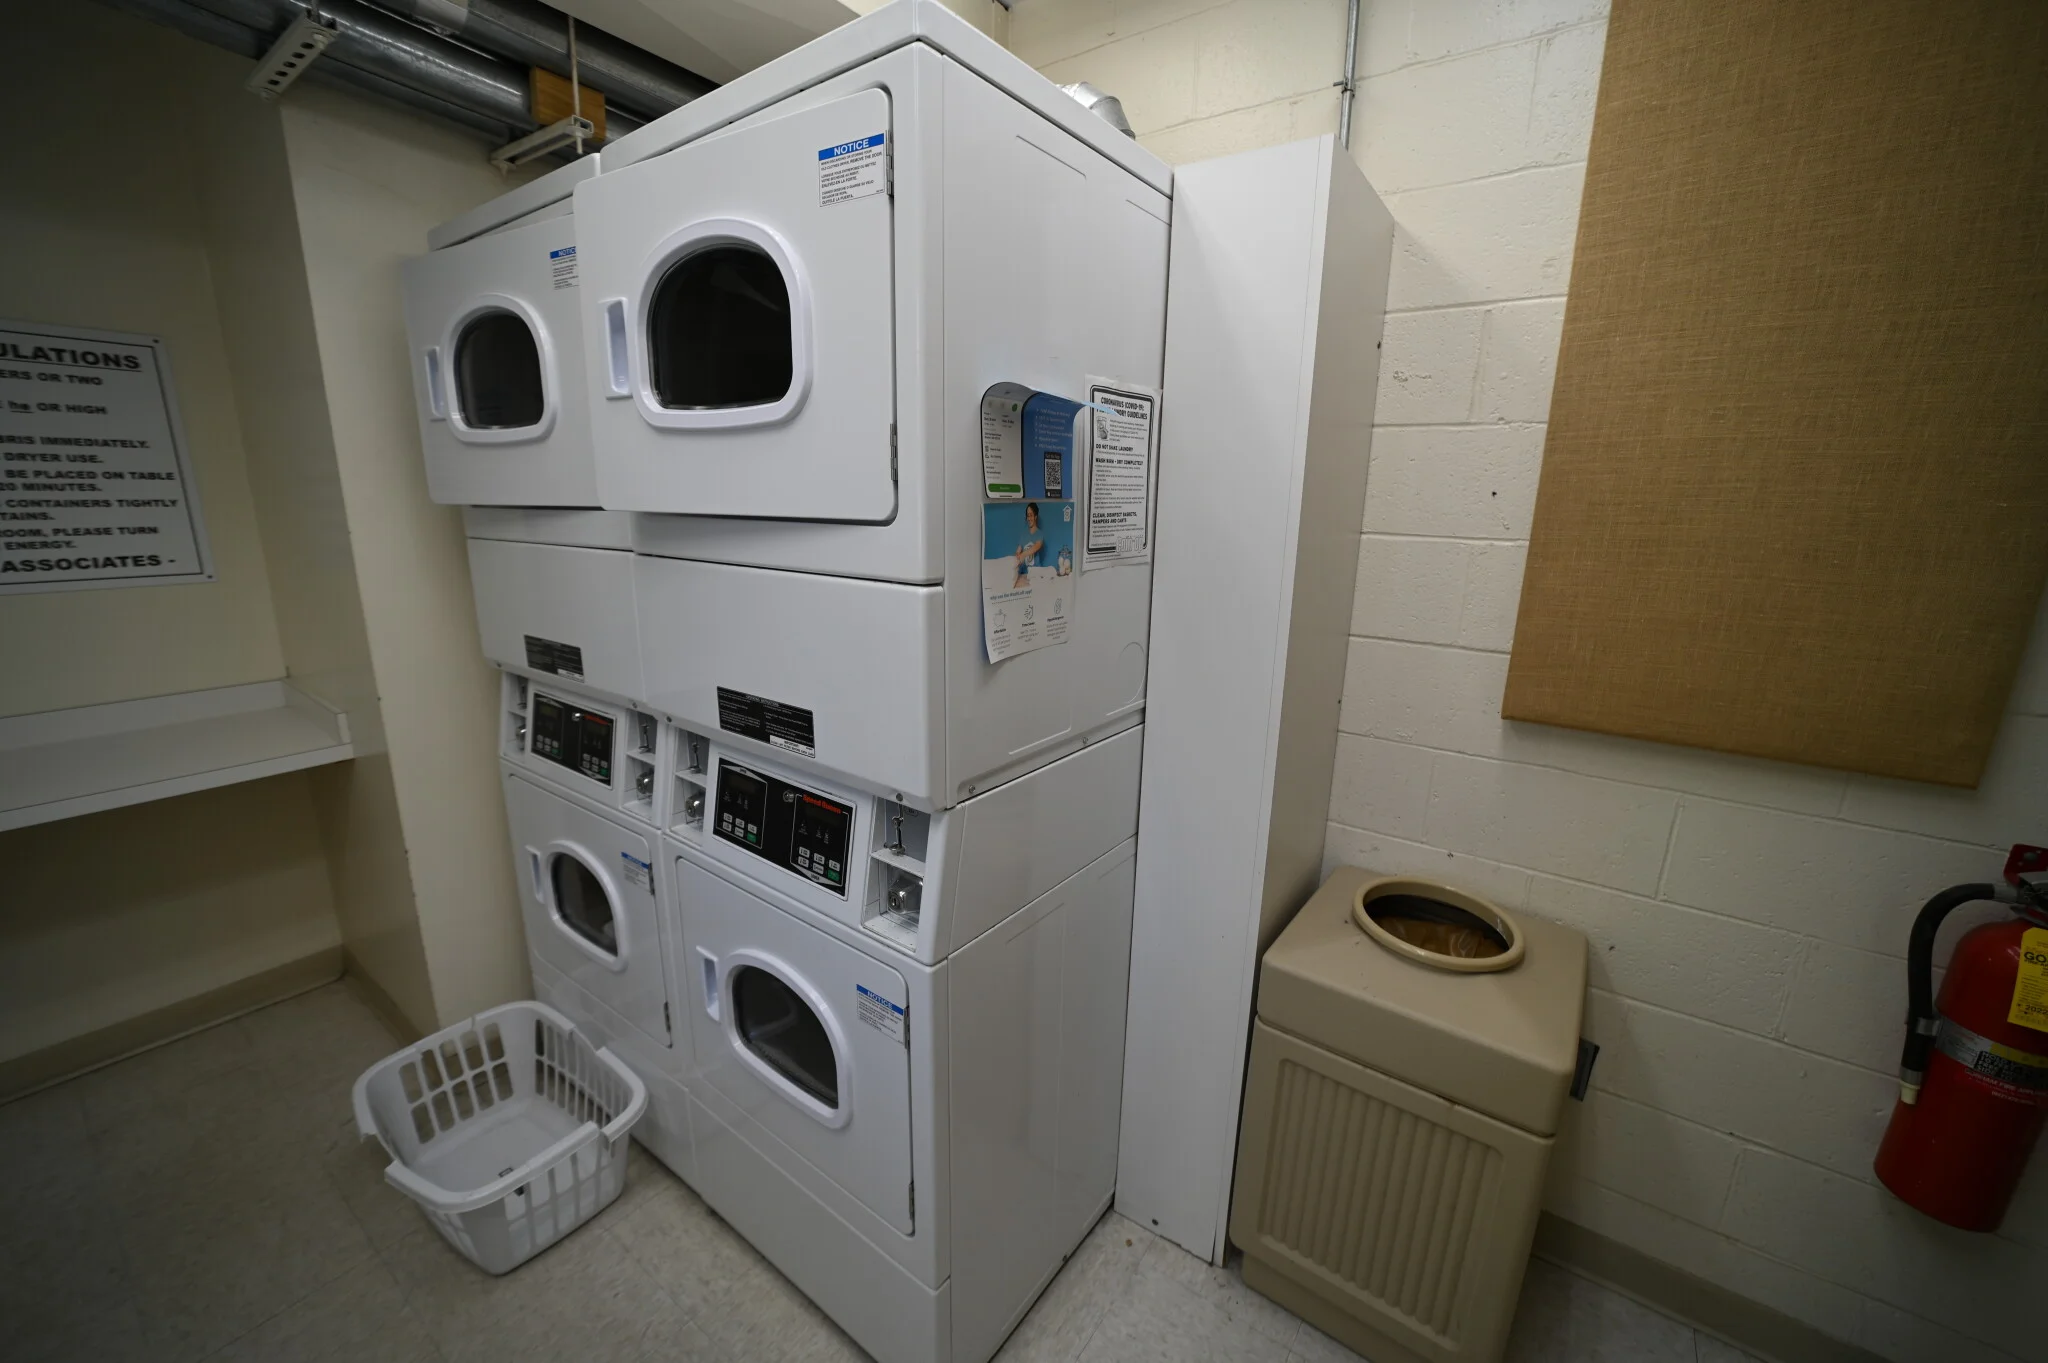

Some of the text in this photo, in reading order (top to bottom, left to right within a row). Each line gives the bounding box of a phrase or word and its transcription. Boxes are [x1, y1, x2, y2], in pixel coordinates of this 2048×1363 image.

[834, 139, 869, 156] NOTICE
[36, 372, 62, 382] OR
[65, 374, 103, 385] TWO
[36, 402, 61, 412] OR
[65, 404, 108, 414] HIGH
[40, 436, 150, 449] IMMEDIATELY.
[4, 452, 103, 464] DRYER USE.
[4, 469, 176, 481] BE PLACED ON TABLE
[22, 482, 103, 492] MINUTES.
[5, 499, 178, 508] CONTAINERS TIGHTLY
[52, 527, 113, 537] PLEASE
[117, 526, 158, 535] TURN
[4, 540, 77, 550] ENERGY.
[1, 555, 162, 573] ASSOCIATES
